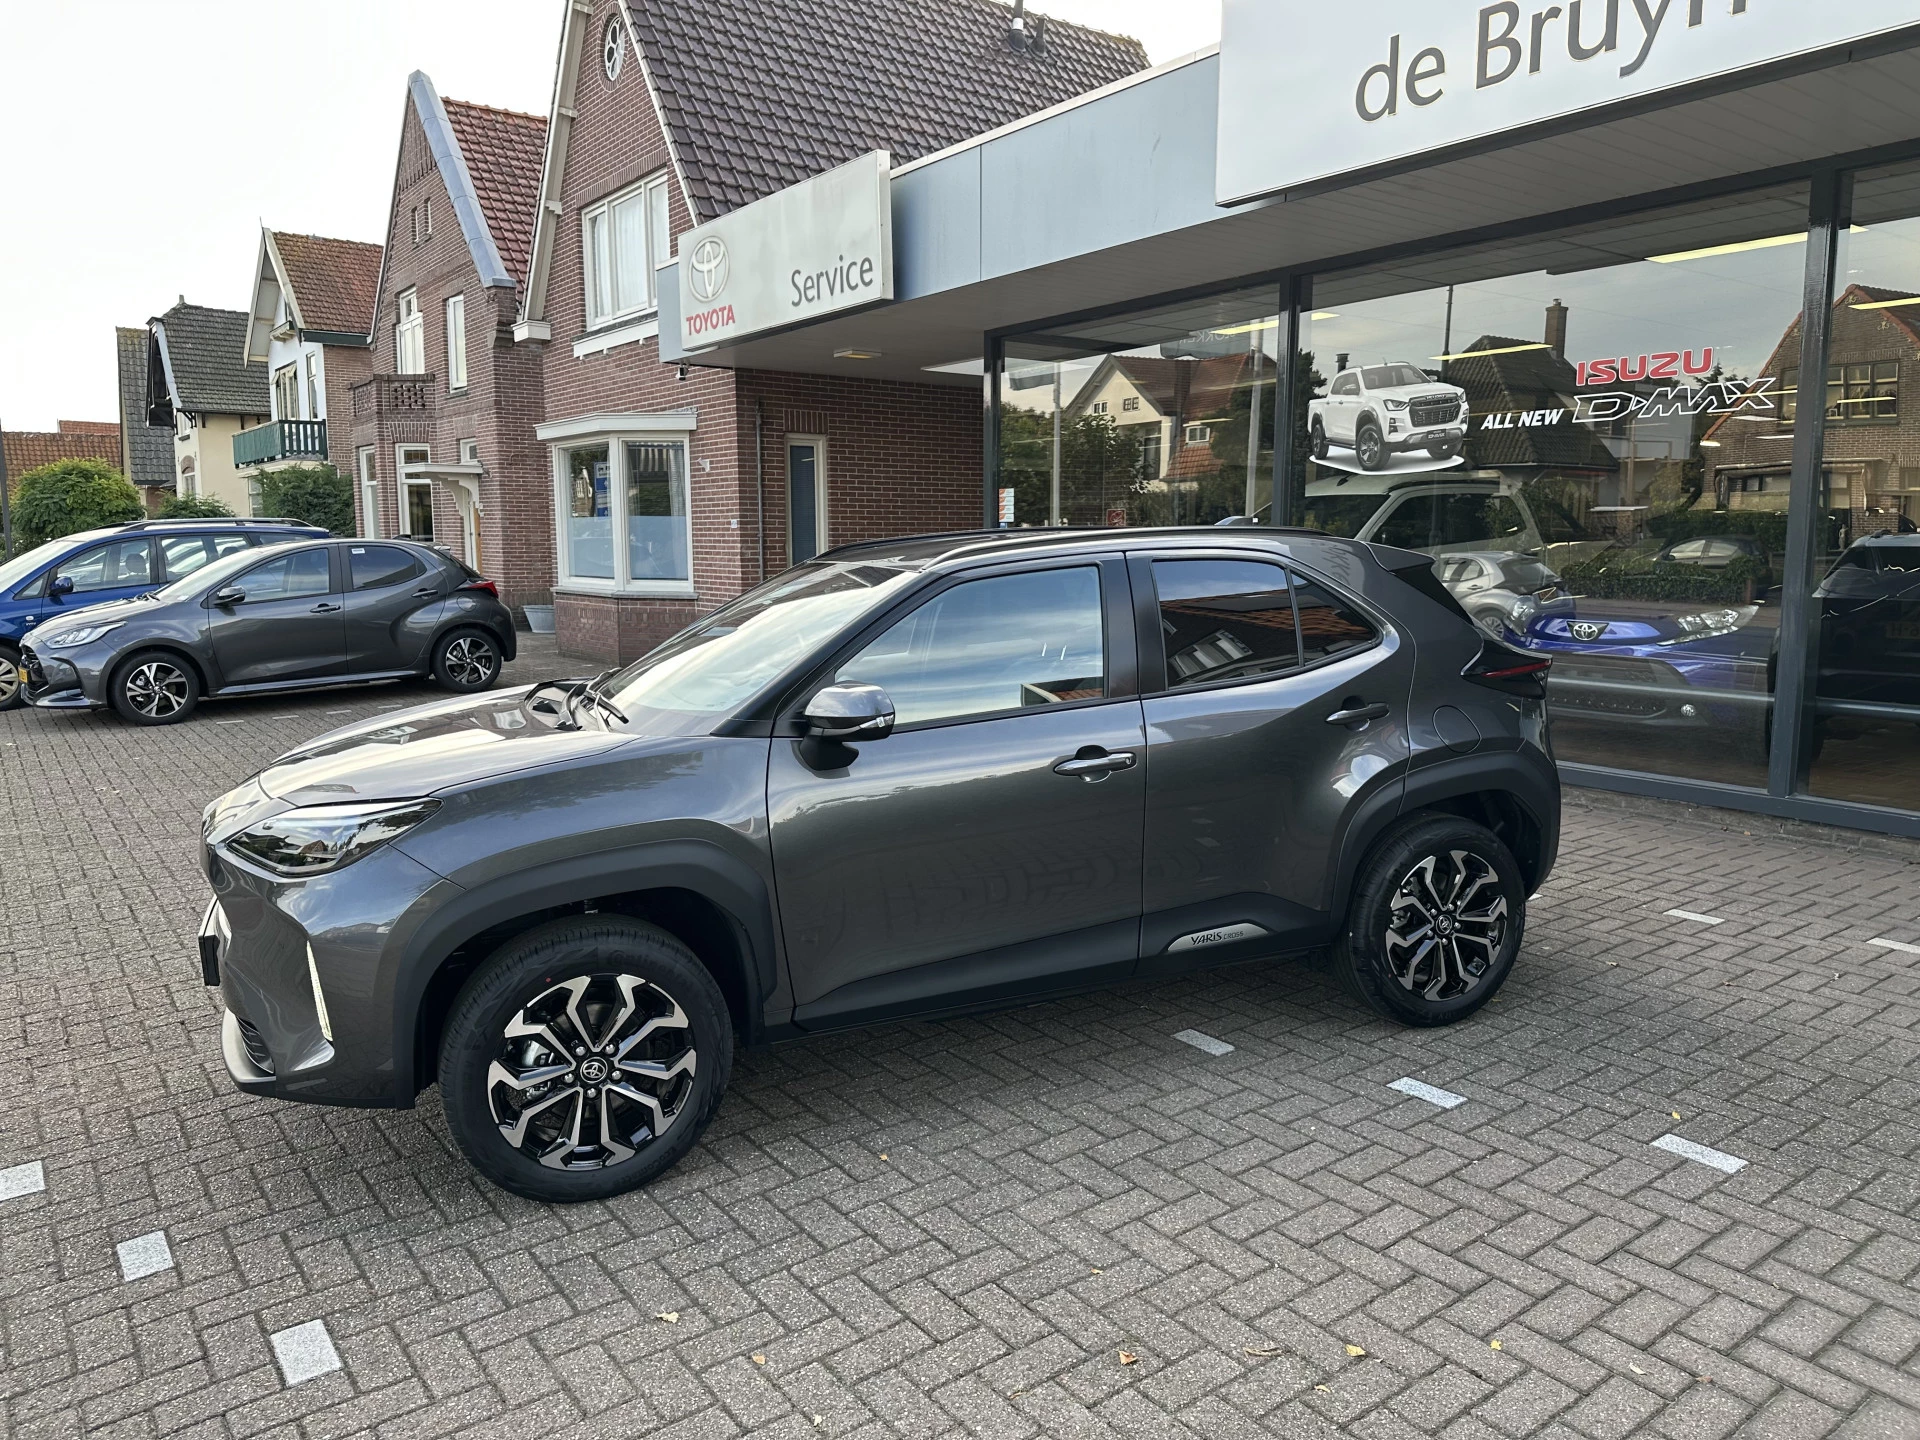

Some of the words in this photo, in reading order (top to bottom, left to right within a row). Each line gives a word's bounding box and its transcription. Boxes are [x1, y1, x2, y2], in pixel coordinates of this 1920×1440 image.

[1354, 33, 1446, 123] de
[791, 254, 874, 308] Service
[686, 304, 736, 336] TOYOTA
[1575, 346, 1714, 387] ISUZU
[1480, 410, 1514, 431] ALL
[1517, 407, 1565, 428] NEW
[1223, 931, 1244, 940] CROSS
